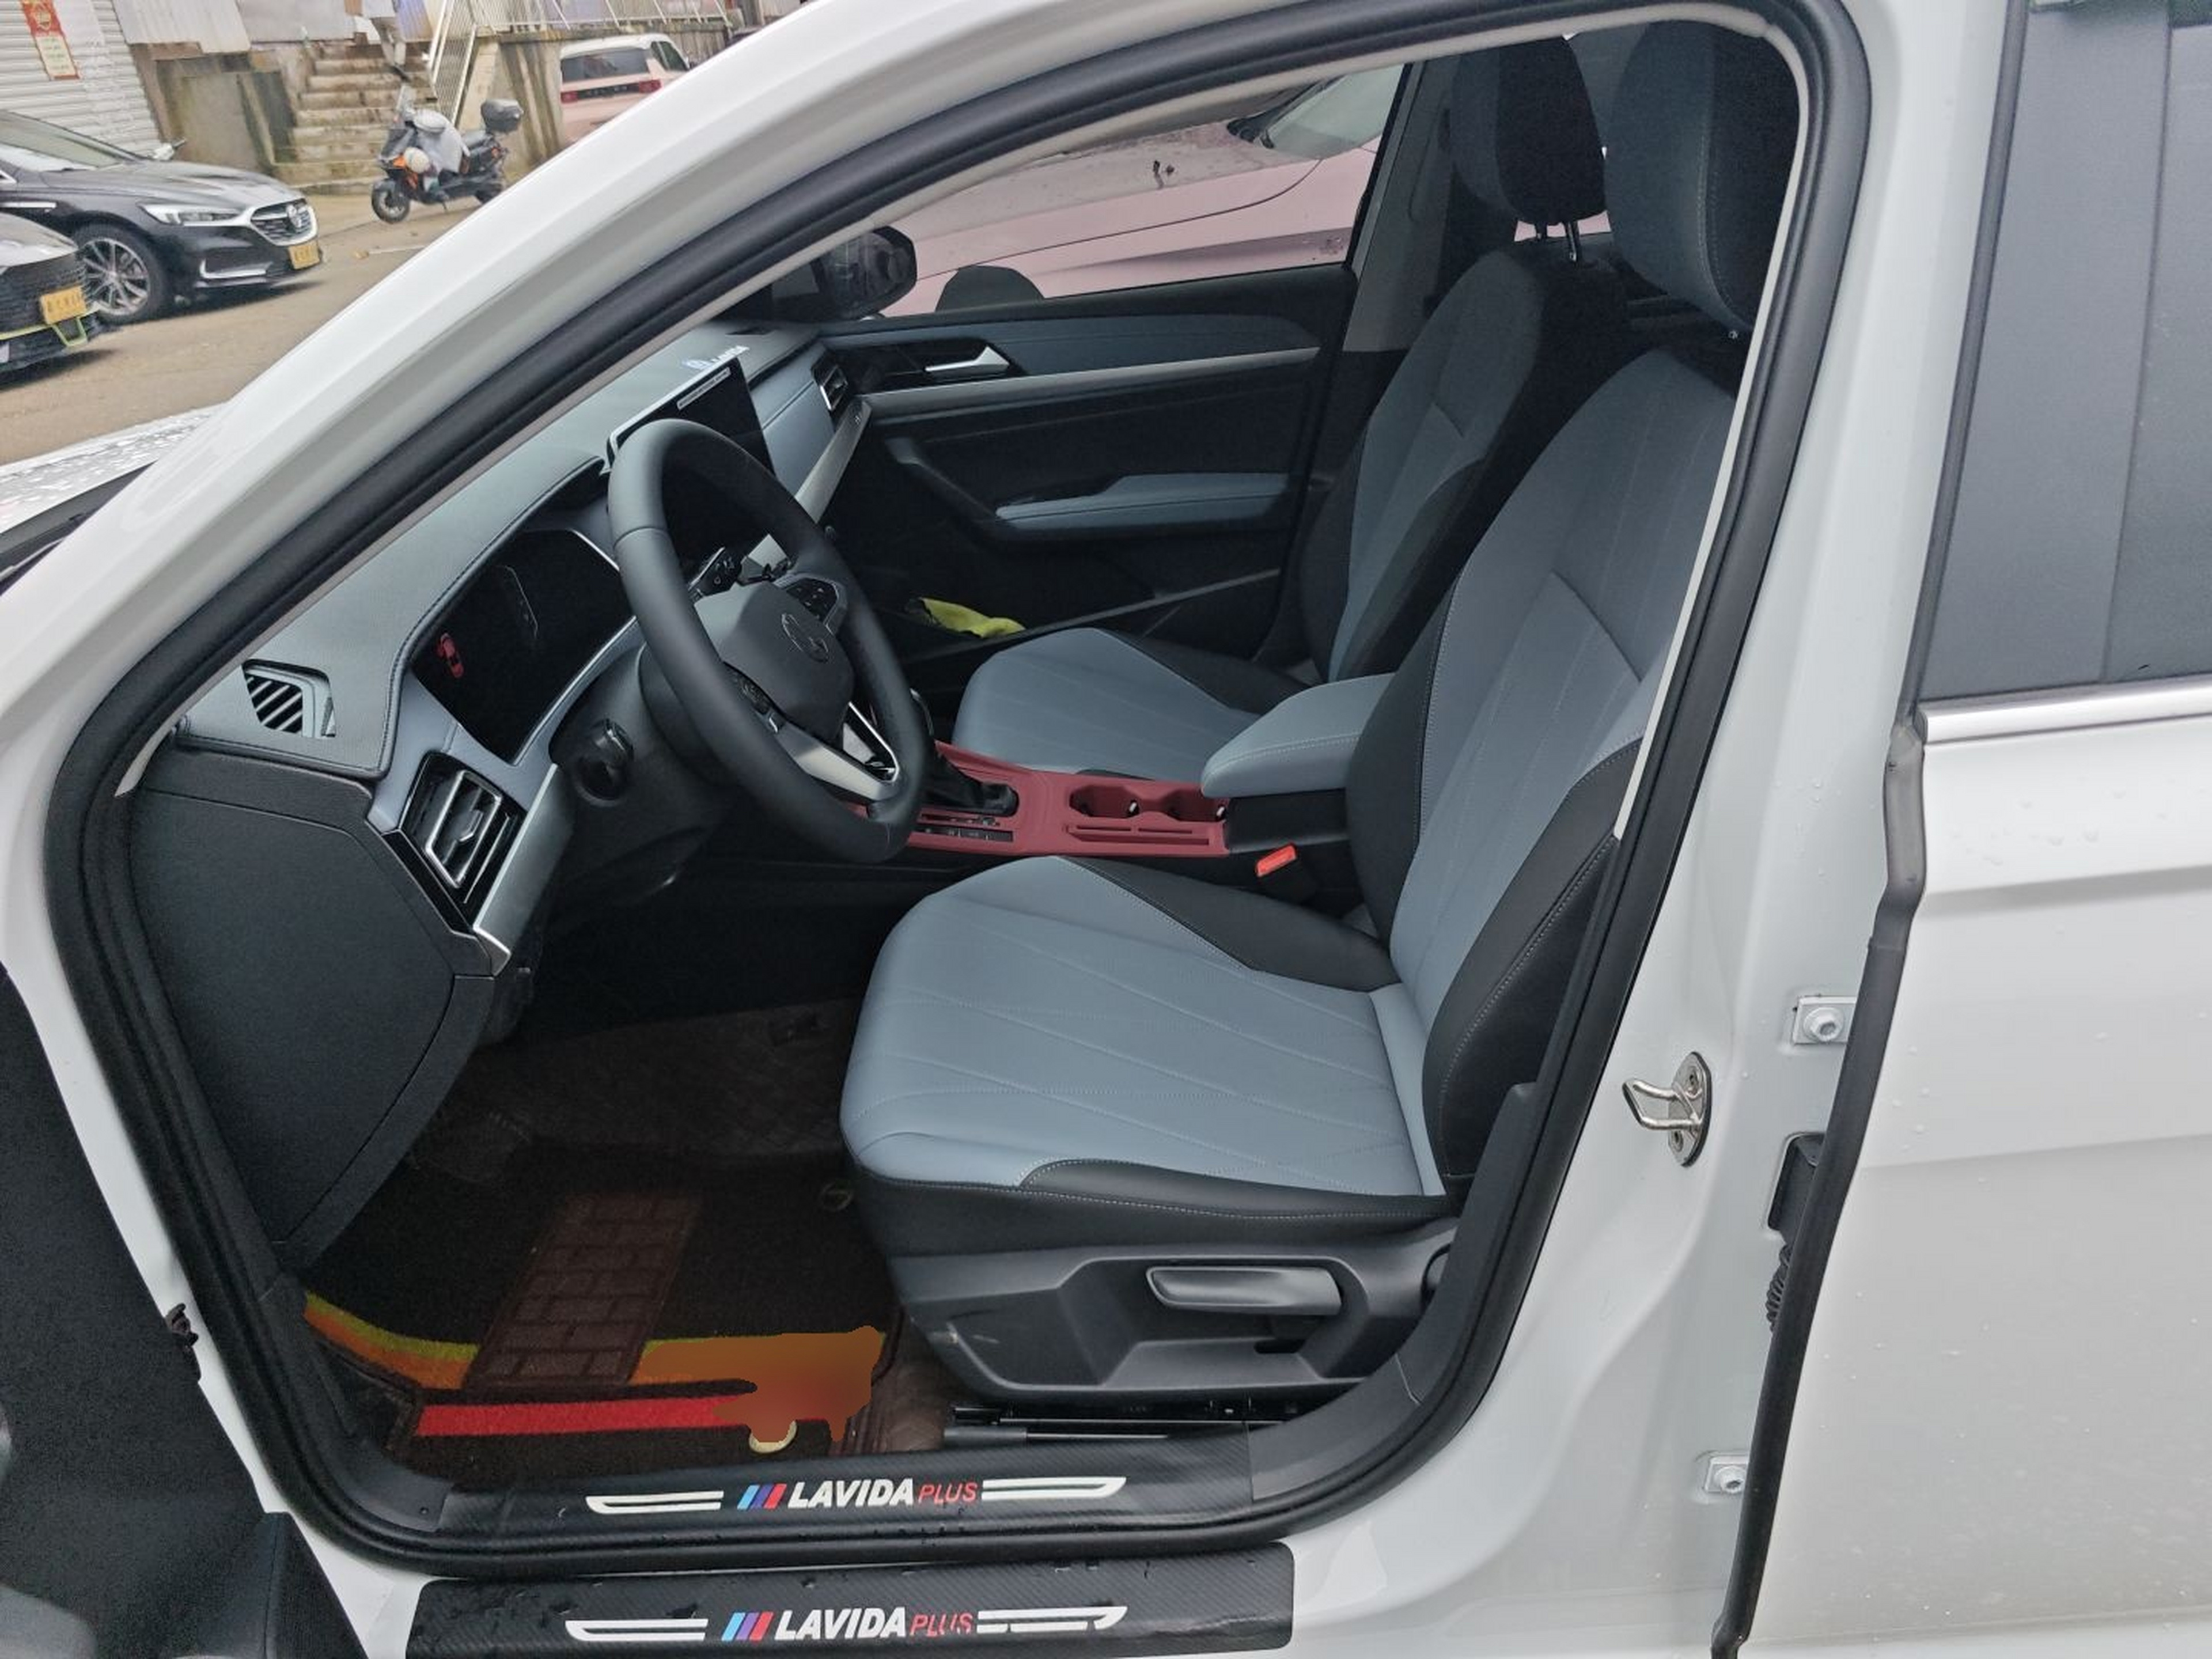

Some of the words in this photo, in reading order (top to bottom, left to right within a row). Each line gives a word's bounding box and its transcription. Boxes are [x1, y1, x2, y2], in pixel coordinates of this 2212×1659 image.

[787, 1478, 914, 1508] LAVIDA
[918, 1482, 978, 1504] PLUS
[774, 1607, 906, 1640] LAVIDA
[910, 1612, 973, 1637] PLUS
